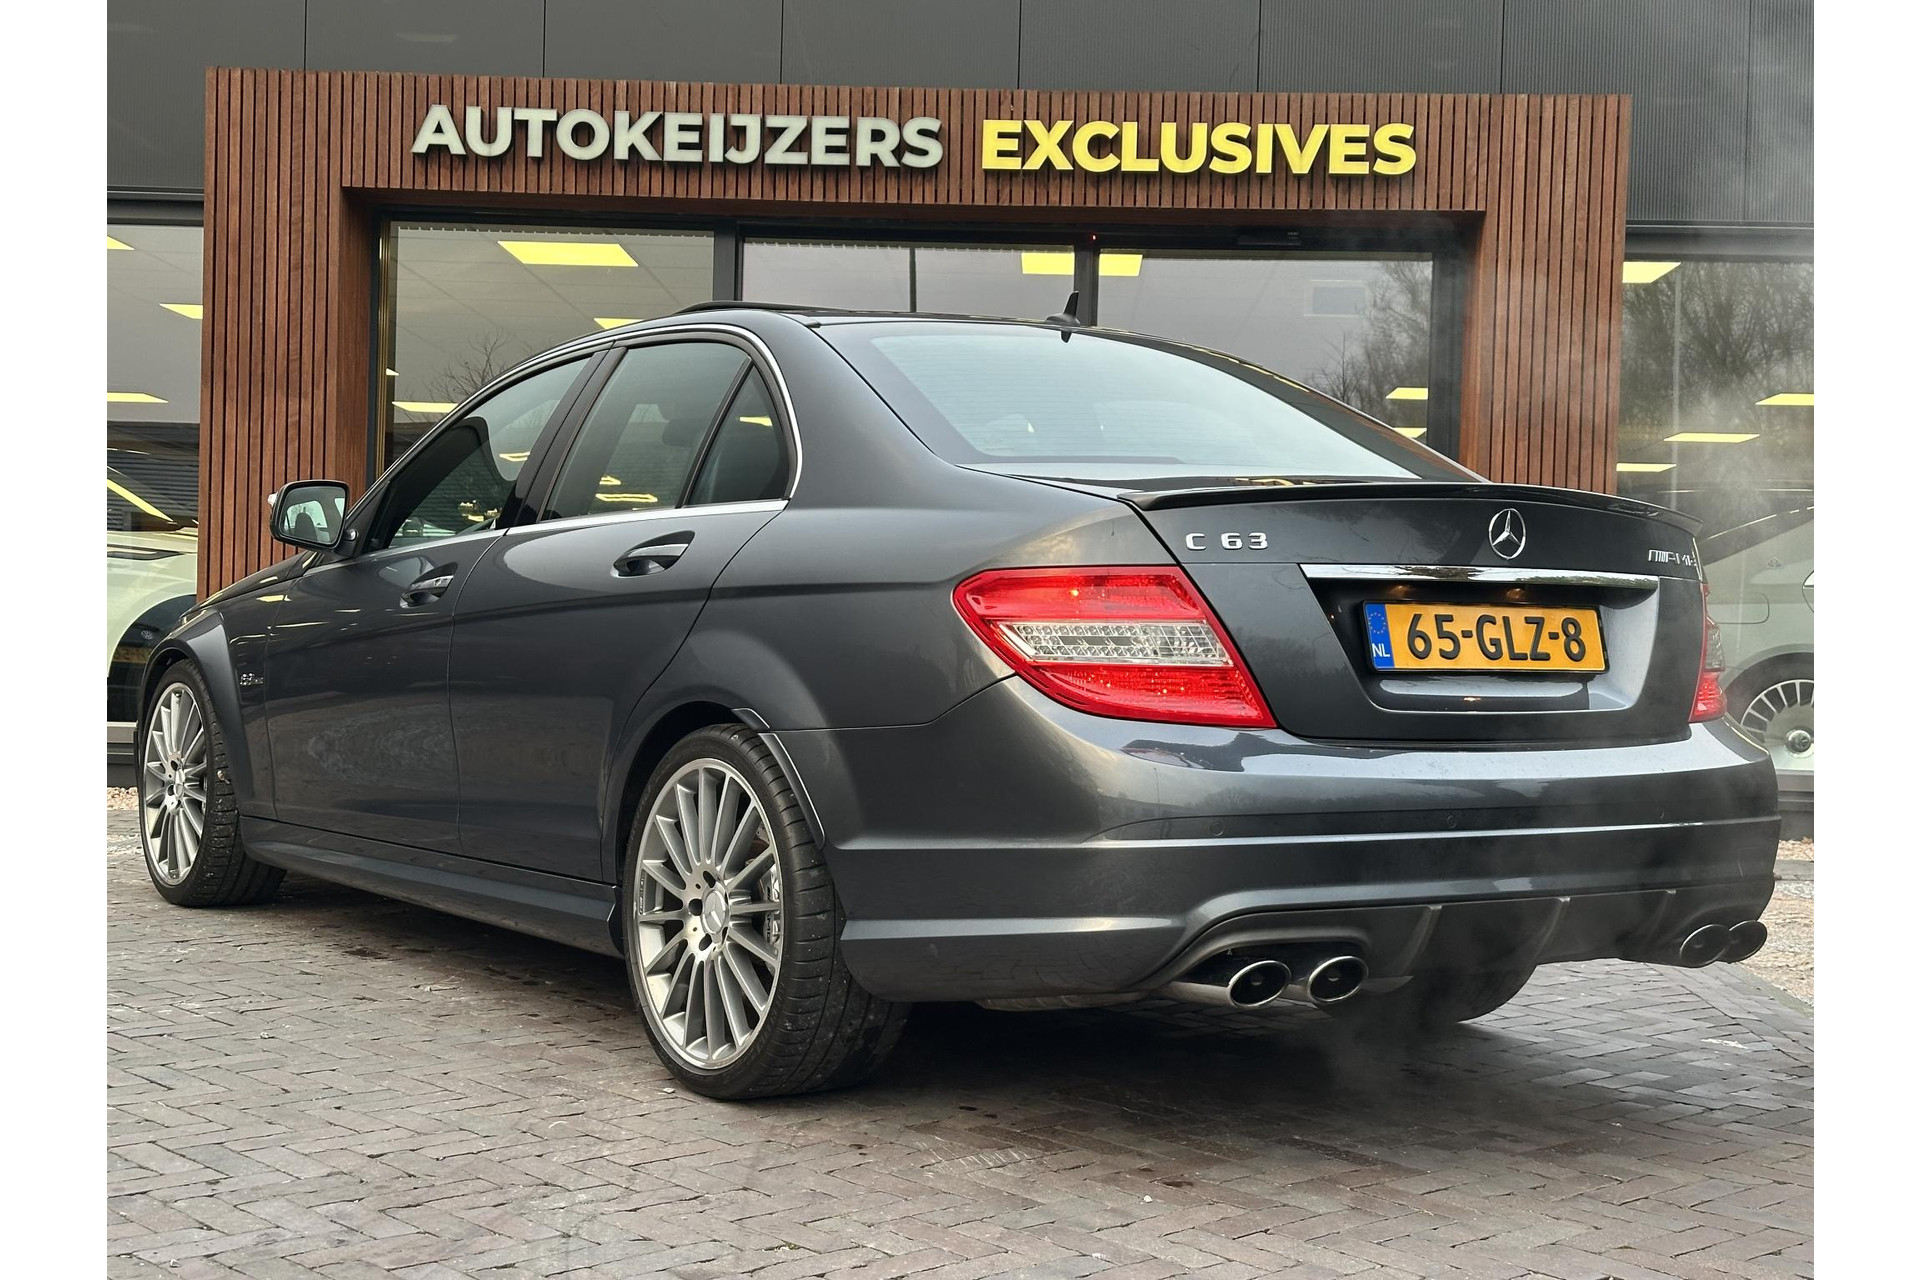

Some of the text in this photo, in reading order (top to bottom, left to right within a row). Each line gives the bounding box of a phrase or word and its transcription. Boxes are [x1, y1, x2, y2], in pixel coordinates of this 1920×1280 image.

[411, 104, 1417, 176] AUTOKEIJZERS EXCLUSIVES
[1185, 532, 1268, 551] C 63
[1371, 642, 1391, 658] NL
[1407, 613, 1586, 662] 65-GLZ-8
